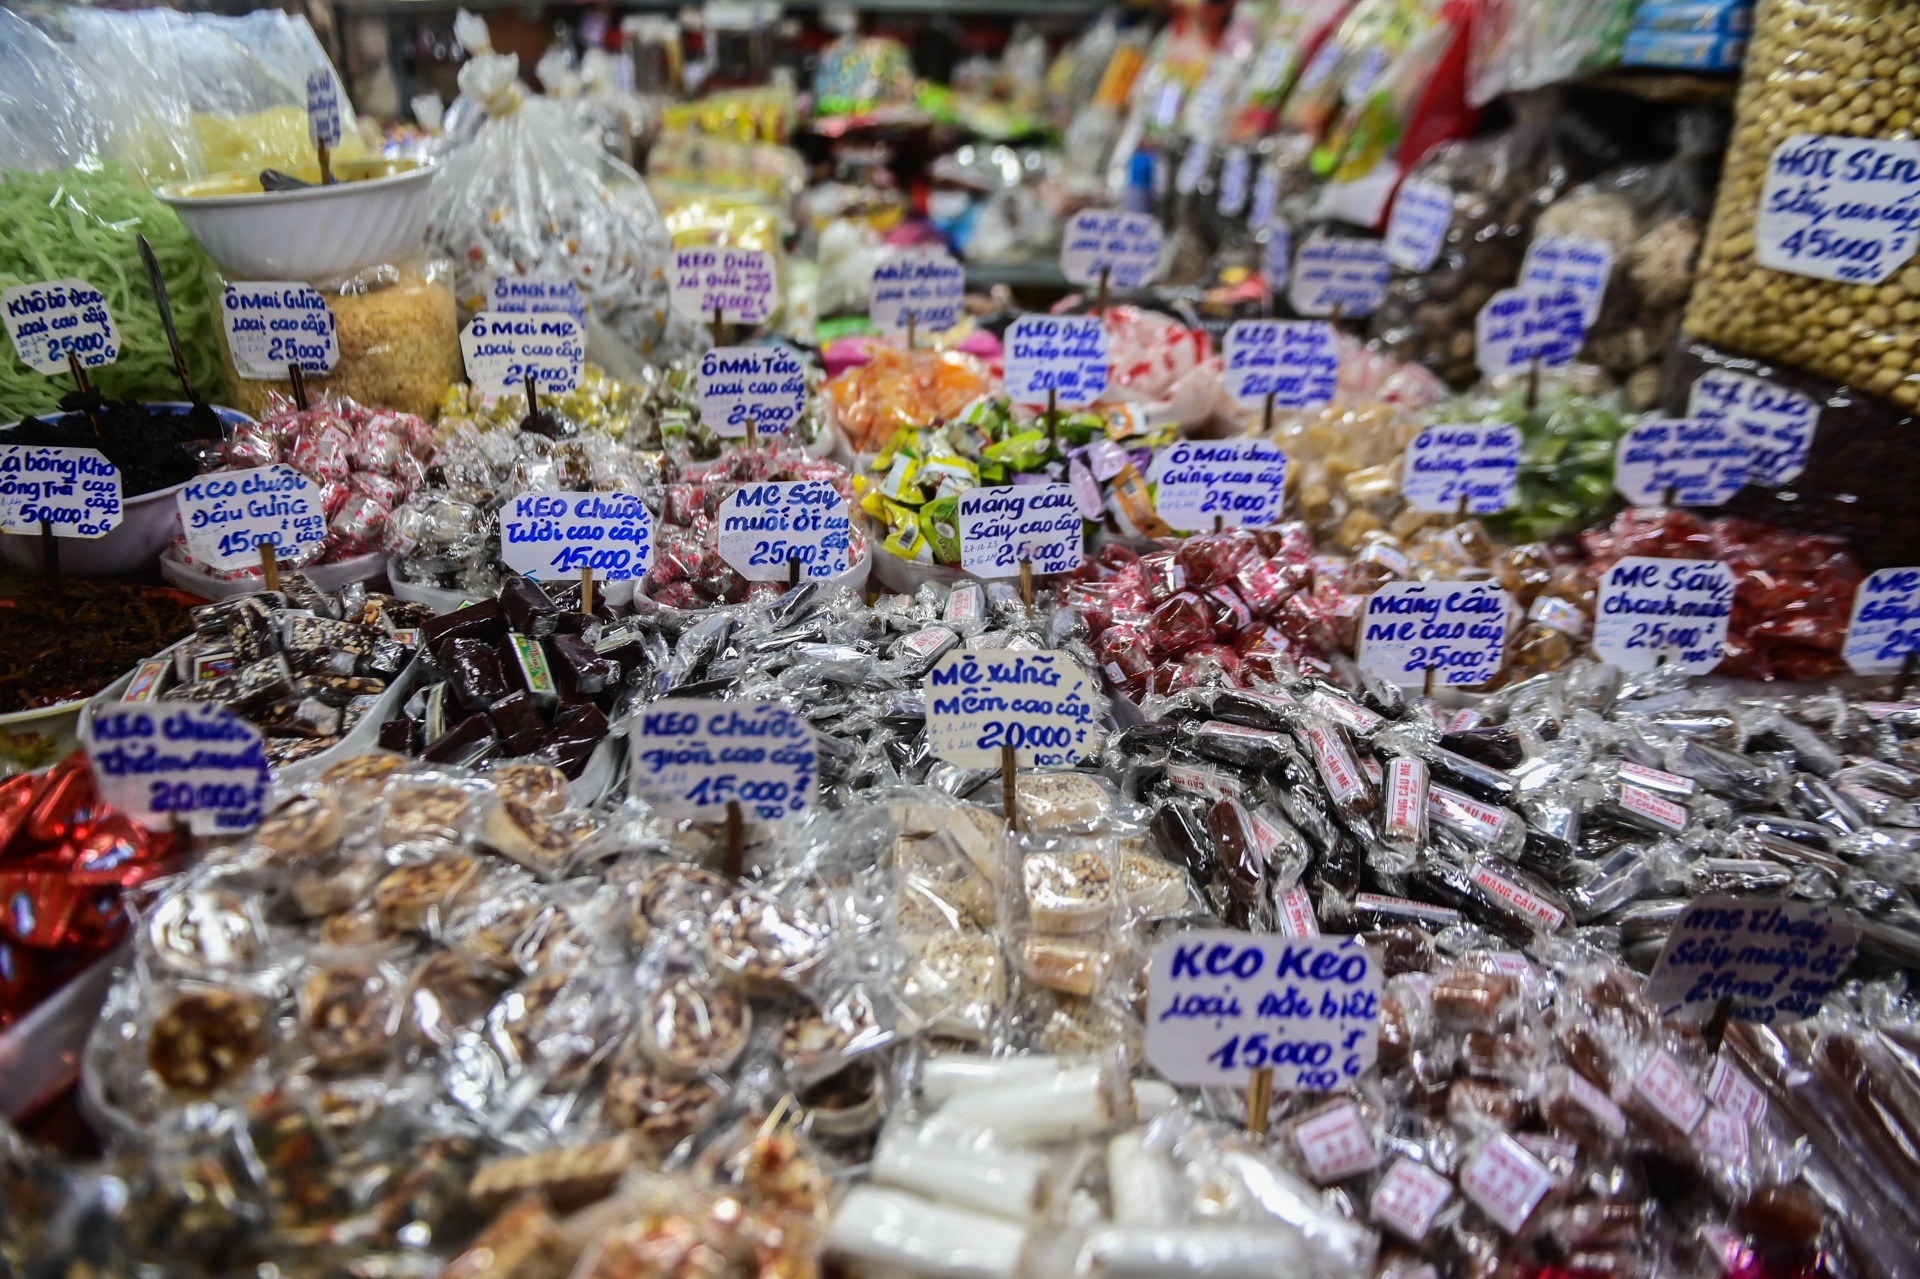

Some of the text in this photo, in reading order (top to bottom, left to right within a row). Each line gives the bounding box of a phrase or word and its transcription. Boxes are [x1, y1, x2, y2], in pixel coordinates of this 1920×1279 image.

[225, 287, 240, 310] Ô
[52, 316, 78, 329] cao
[270, 318, 299, 331] cao
[472, 316, 487, 336] Ô
[521, 344, 553, 356] cao
[702, 353, 717, 376] Ô
[749, 381, 777, 394] cao
[1171, 443, 1190, 464] Ô
[82, 480, 116, 491] cao
[786, 481, 841, 511] Sấy
[961, 487, 1025, 520] Mãng
[566, 525, 605, 540] cao
[965, 514, 1017, 541] Sấy
[1019, 520, 1052, 534] cao
[1369, 587, 1443, 624] Mãng
[1421, 622, 1465, 640] cao
[1011, 698, 1052, 714] cao
[1055, 681, 1093, 724] cấp
[719, 747, 766, 763] cao
[1400, 762, 1411, 776] ME
[1336, 775, 1350, 790] ME
[1481, 812, 1498, 827] ME
[1538, 907, 1556, 922] ME
